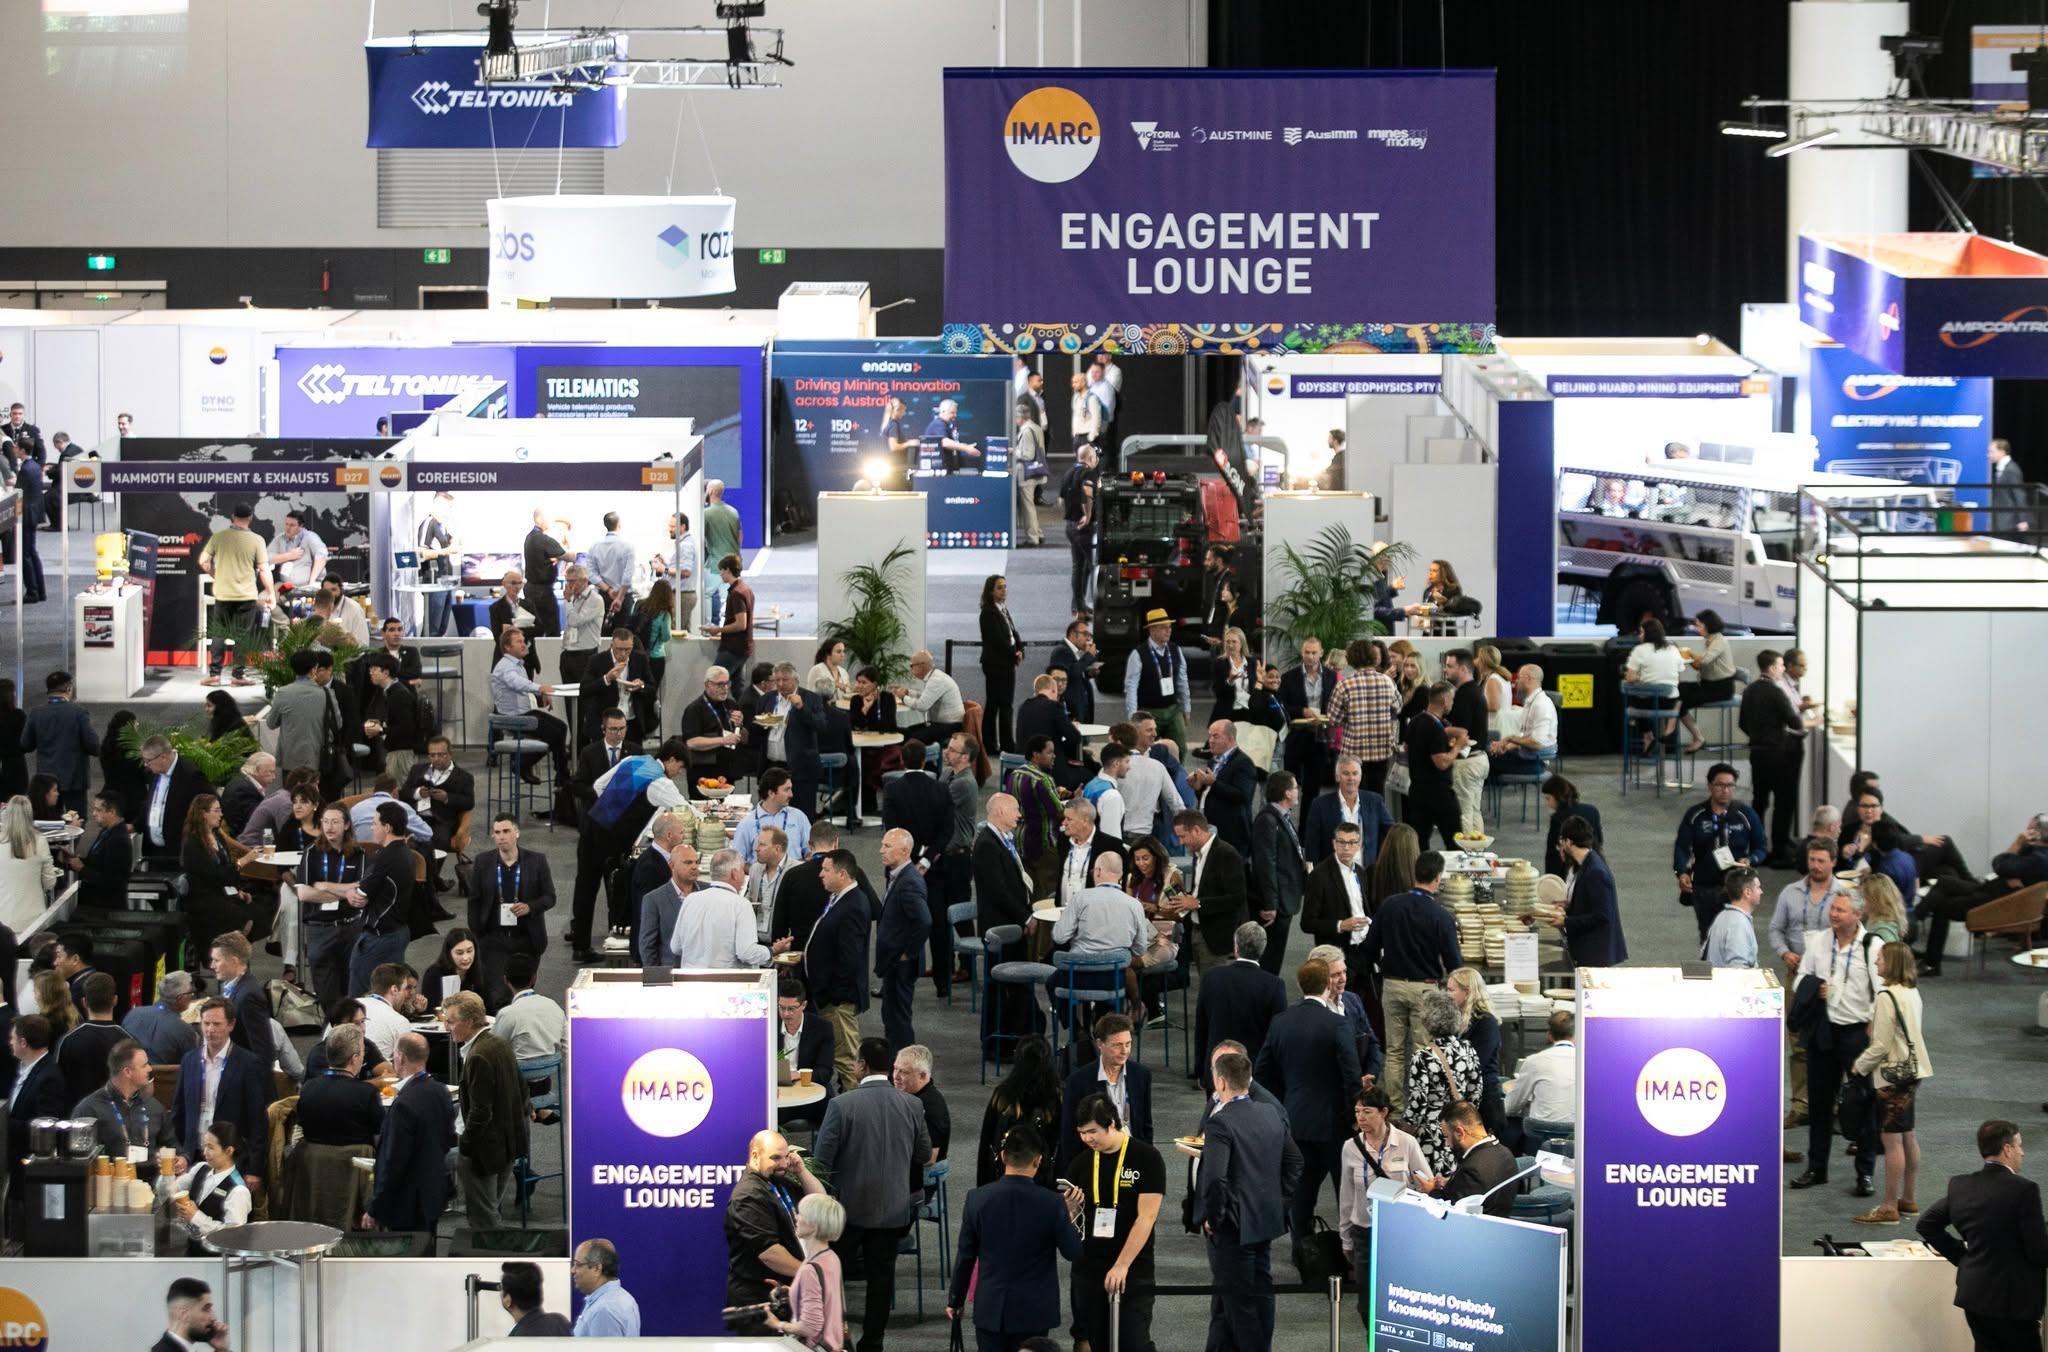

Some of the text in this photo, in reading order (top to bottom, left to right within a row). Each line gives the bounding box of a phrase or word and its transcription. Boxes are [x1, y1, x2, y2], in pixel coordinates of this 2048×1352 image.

[448, 90, 573, 107] TELTONIKA
[1012, 122, 1093, 145] IMARC
[1137, 131, 1180, 139] VICTORIA
[1209, 130, 1272, 140] AUSTMINE
[1368, 129, 1409, 140] mines
[1386, 138, 1427, 149] money
[1061, 212, 1379, 249] ENGAGEMENT
[1128, 257, 1312, 294] LOUNGE
[862, 361, 912, 373] endava
[546, 378, 639, 398] TELEMATICS
[795, 379, 960, 394] Driving Mining Innovation
[1298, 382, 1345, 393] ODYSSEY
[1348, 382, 1413, 393] GEOPHYSICS
[1416, 382, 1435, 393] PTY
[1554, 382, 1596, 394] BEIJING
[1637, 382, 1676, 394] MINING
[1678, 382, 1739, 394] EQUIPMENT
[795, 395, 893, 407] across Australi
[111, 473, 330, 484] MAMMOTH EQUIPMENT & EXHAUSTS
[344, 473, 363, 482] D27
[417, 472, 497, 483] COREHESION
[945, 497, 975, 505] endava
[632, 1080, 705, 1101] IMARC
[1645, 1080, 1718, 1101] IMARC
[592, 1165, 747, 1185] ENGAGEMENT
[1606, 1164, 1759, 1184] ENGAGEMENT
[624, 1188, 715, 1208] LOUNGE
[1636, 1187, 1727, 1207] LOUNGE
[1388, 1283, 1496, 1319] Integrated Orebody
[1388, 1299, 1504, 1335] Knowledge Solutions
[1380, 1324, 1396, 1334] DATA
[1406, 1330, 1415, 1338] AI
[1446, 1337, 1474, 1352] Strata
